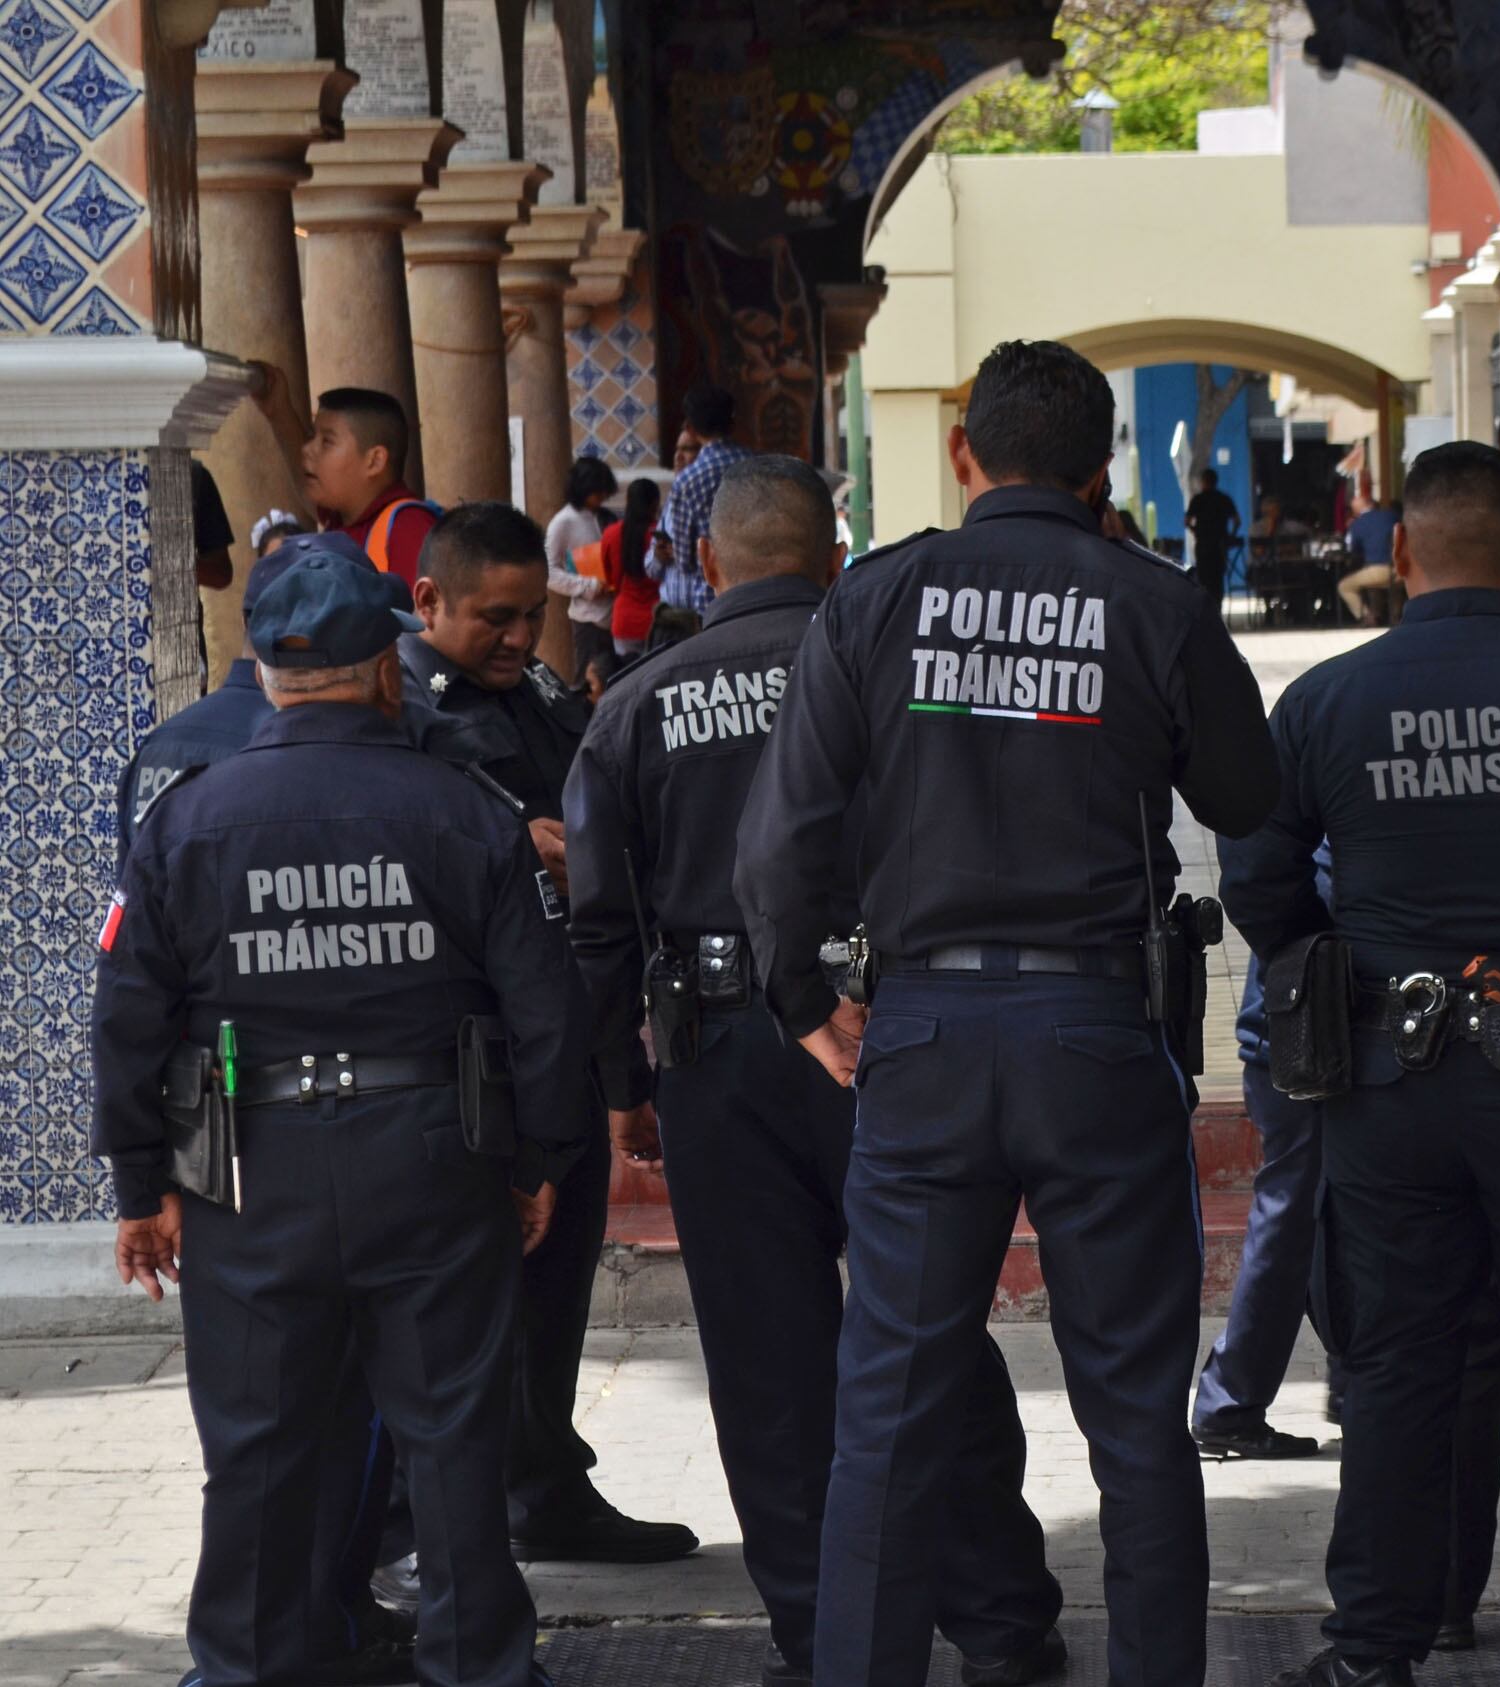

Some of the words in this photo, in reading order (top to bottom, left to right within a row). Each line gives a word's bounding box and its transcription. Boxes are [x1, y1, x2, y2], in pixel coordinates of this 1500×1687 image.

[919, 587, 1105, 651] POLICÍA
[655, 665, 792, 718] TRÁNS
[912, 646, 1104, 714] TRÁNSITO
[247, 856, 413, 913] POLICÍA
[229, 919, 436, 975] TRÁNSITO
